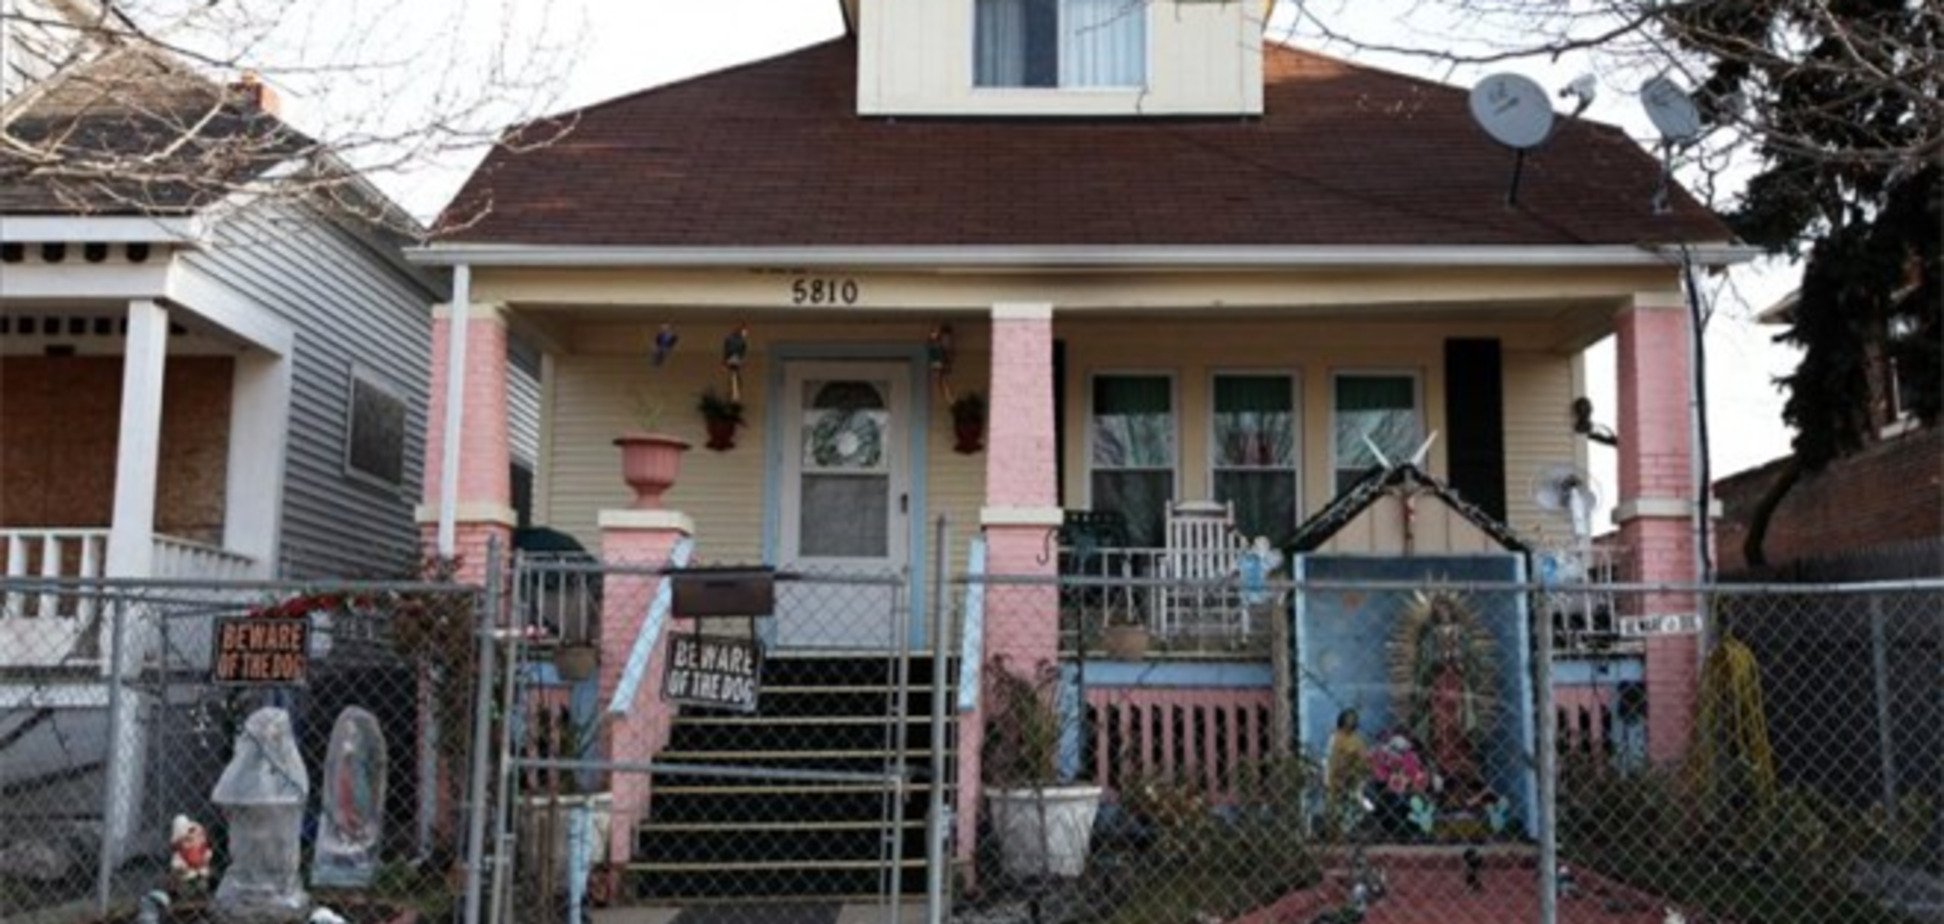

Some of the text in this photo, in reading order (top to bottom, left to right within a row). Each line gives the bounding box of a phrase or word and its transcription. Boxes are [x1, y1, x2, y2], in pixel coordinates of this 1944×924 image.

[792, 279, 858, 304] 5810
[223, 623, 302, 650] BEWARE
[217, 652, 239, 679] OF
[241, 653, 271, 679] THE
[674, 639, 753, 676] BEWARE
[668, 669, 755, 705] OF THE DOG
